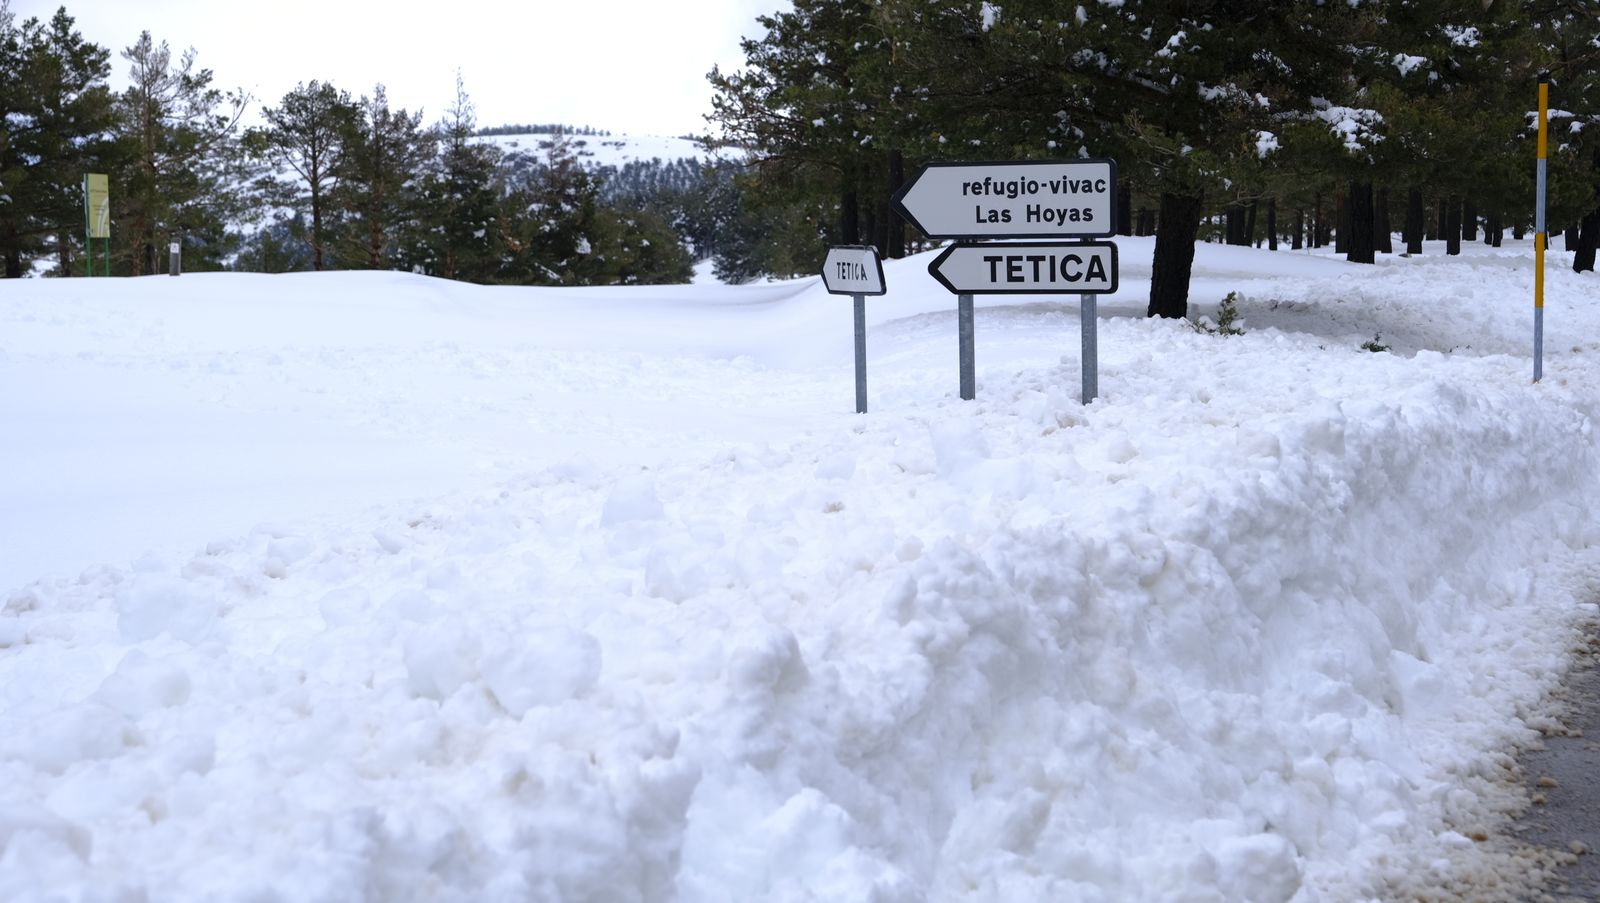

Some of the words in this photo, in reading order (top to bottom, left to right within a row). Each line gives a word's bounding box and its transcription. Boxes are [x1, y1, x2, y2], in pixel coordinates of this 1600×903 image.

[962, 175, 1107, 199] refugio-vivac
[975, 205, 1012, 224] Las
[1026, 204, 1094, 226] Hoyas
[836, 261, 868, 281] TETICA
[983, 253, 1108, 284] TETICA
